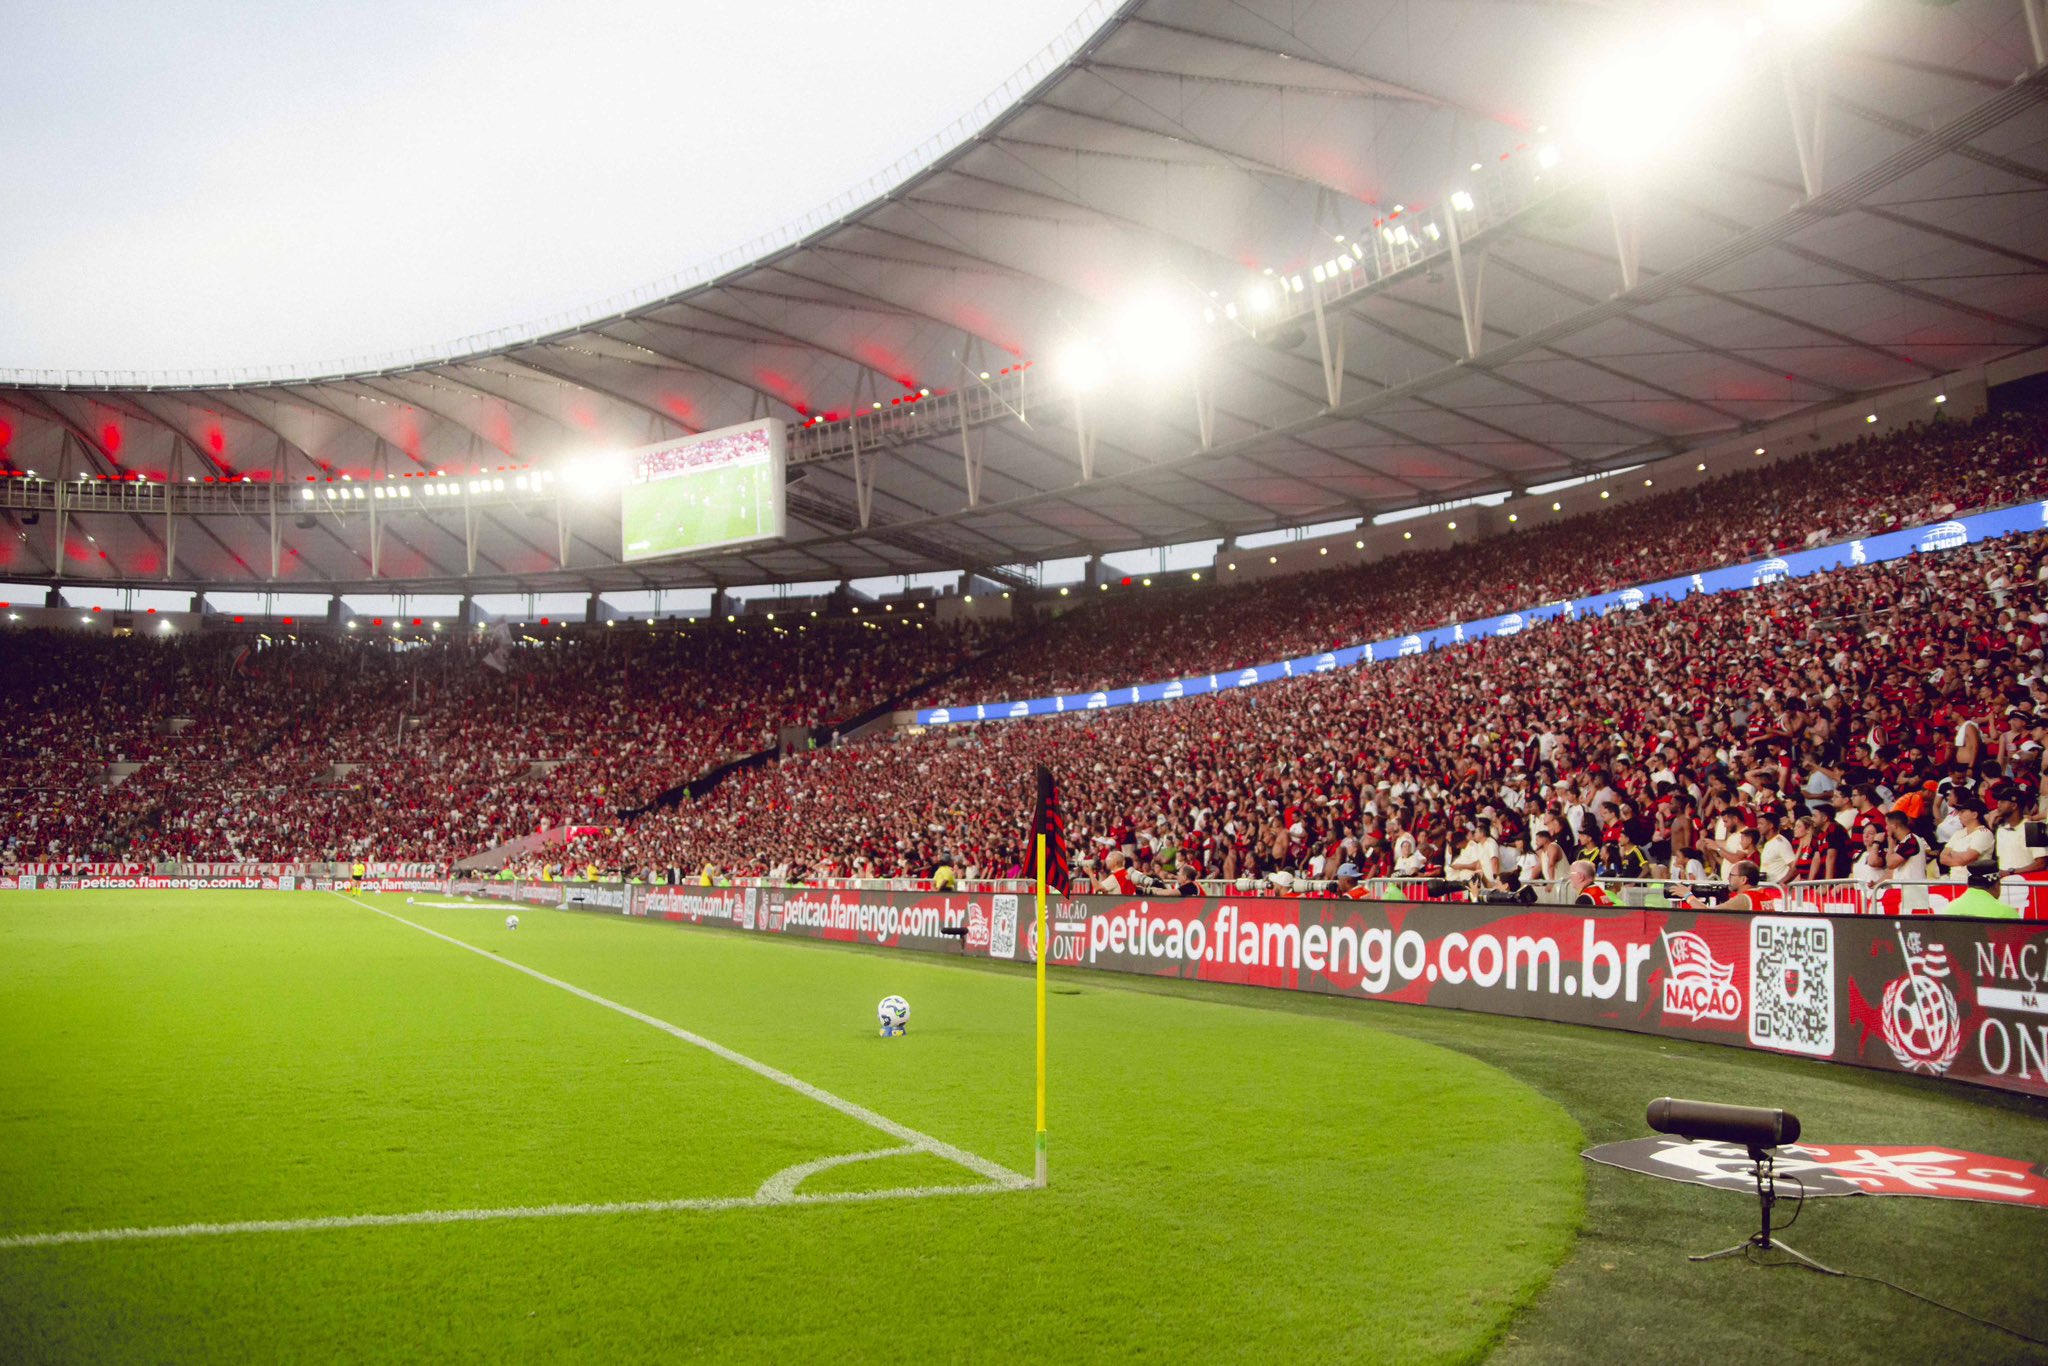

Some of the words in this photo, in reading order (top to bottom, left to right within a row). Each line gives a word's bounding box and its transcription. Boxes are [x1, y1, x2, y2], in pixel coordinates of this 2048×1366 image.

[81, 875, 261, 889] peticao.flamengo.com.br
[645, 887, 734, 921] peticao.flamengo.com.br
[784, 892, 966, 942] peticao.flamengo.com.br
[1055, 901, 1087, 923] NAÇÃO
[1053, 935, 1086, 961] ONU
[1090, 901, 1650, 1003] peticao.flamengo.com.br
[1666, 981, 1739, 1016] NAÇÃO
[2022, 994, 2039, 1008] NA
